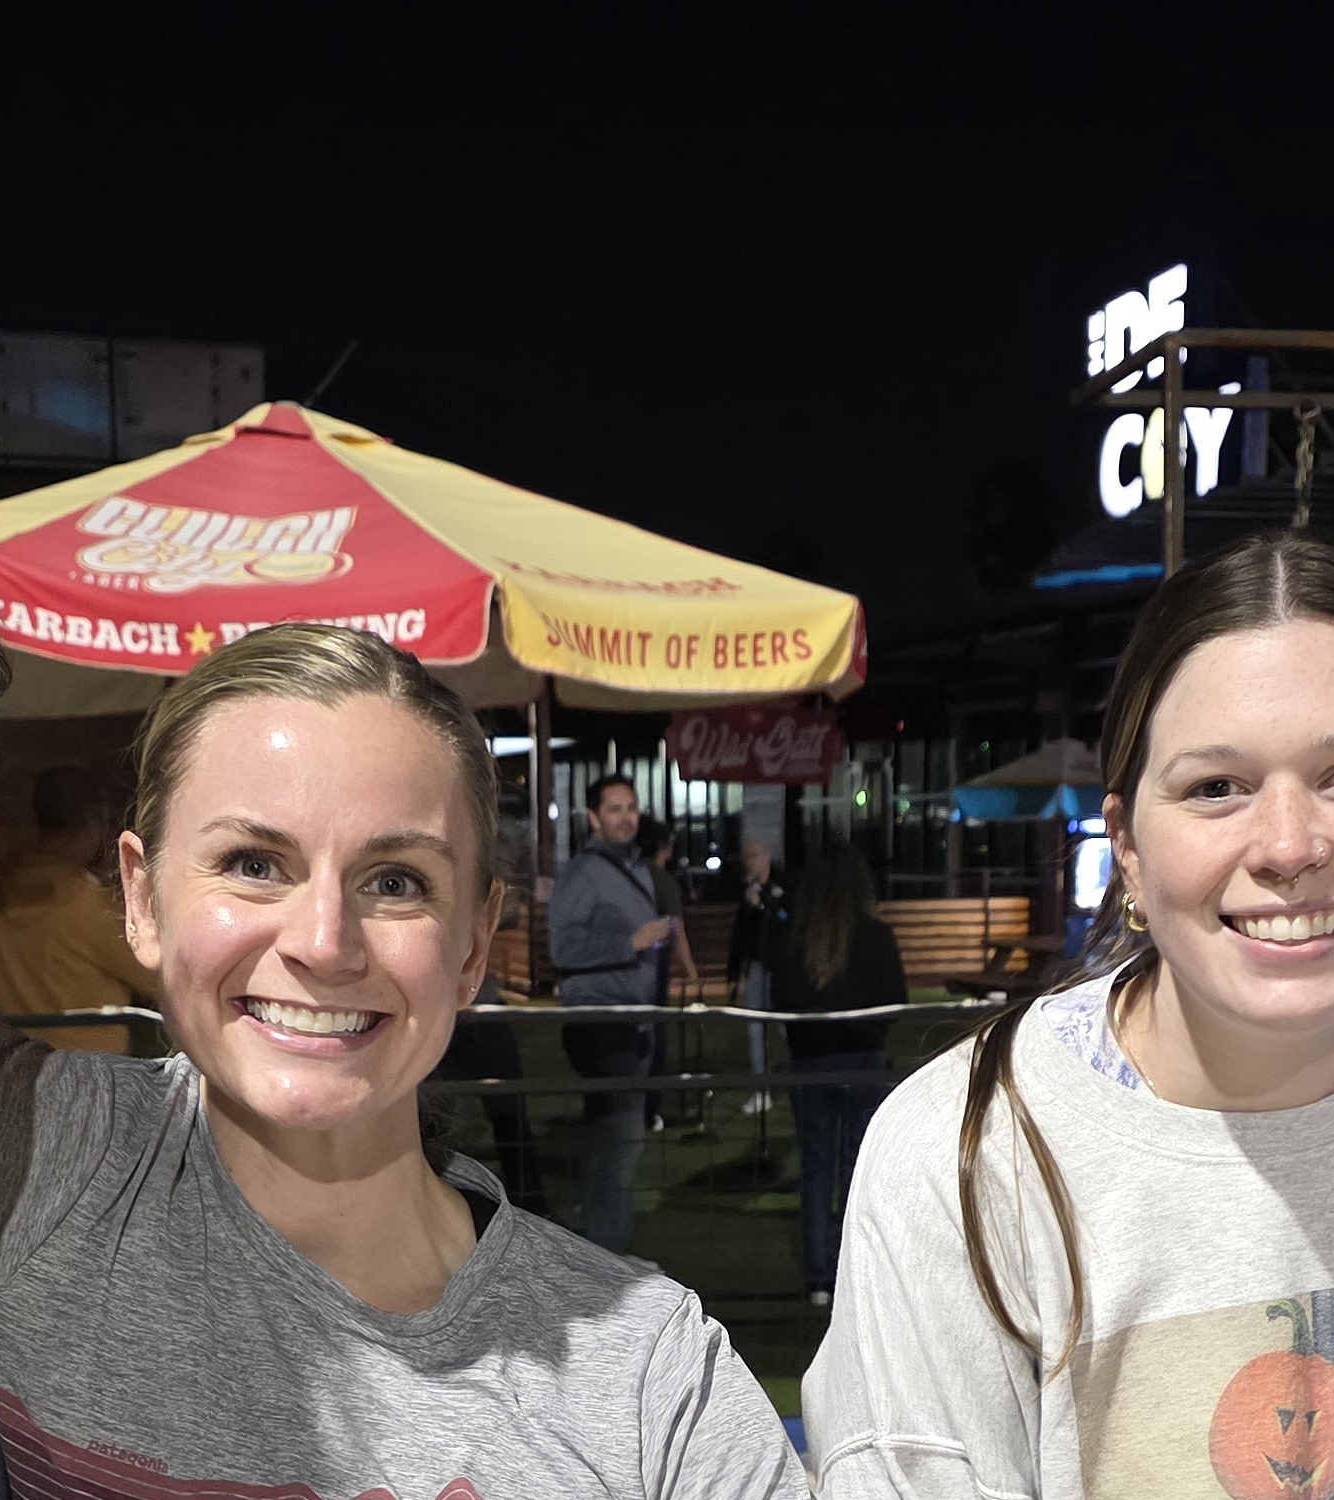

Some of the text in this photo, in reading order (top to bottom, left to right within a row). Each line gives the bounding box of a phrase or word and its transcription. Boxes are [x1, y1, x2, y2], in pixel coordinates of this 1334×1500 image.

[540, 611, 814, 670] SUMMIT OF BEERS
